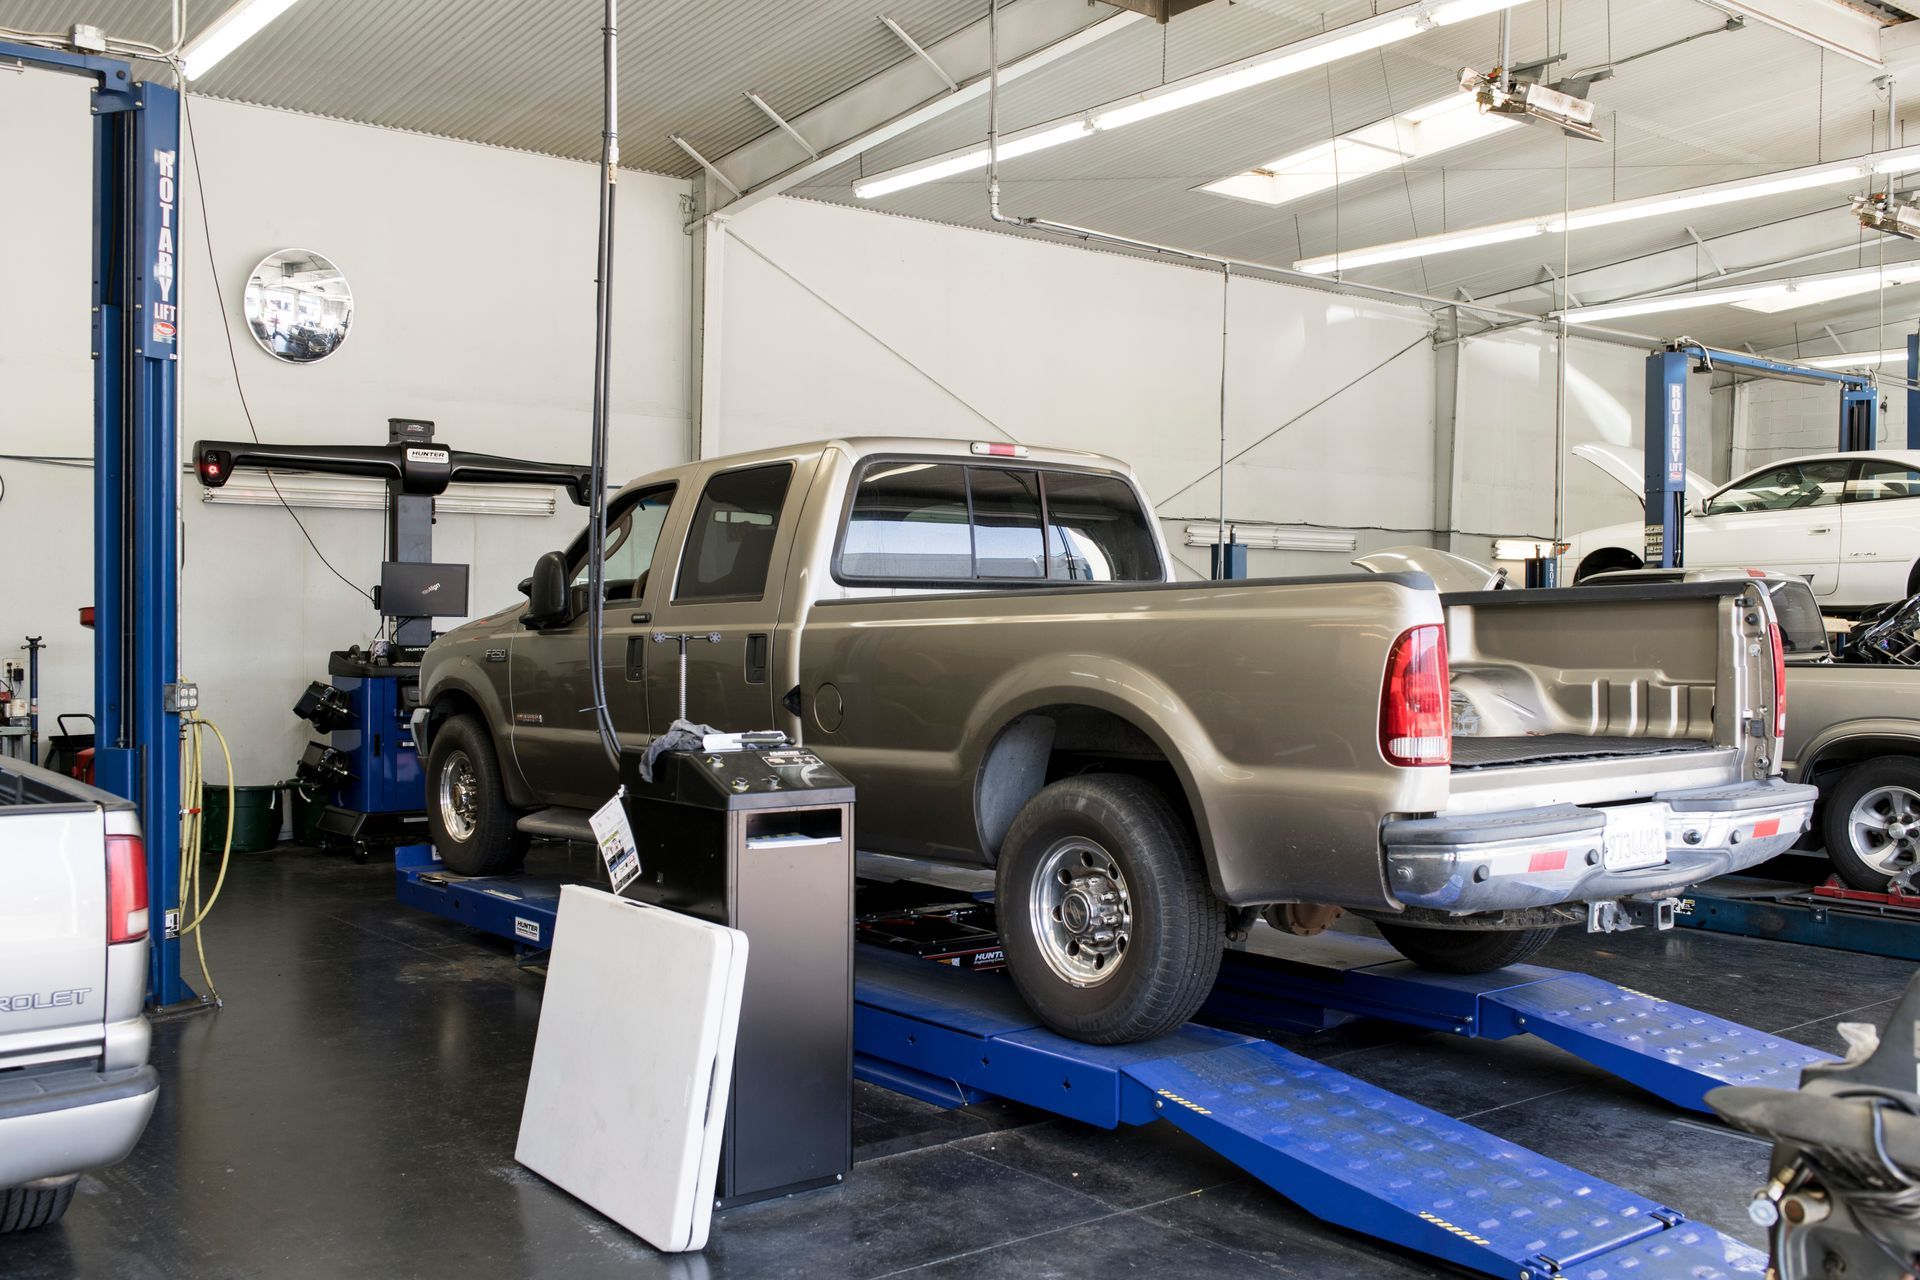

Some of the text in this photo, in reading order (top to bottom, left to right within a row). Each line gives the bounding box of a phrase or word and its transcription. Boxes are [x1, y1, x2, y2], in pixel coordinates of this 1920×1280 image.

[157, 150, 174, 302] ROTARY
[154, 302, 176, 322] LIFT
[1670, 384, 1682, 462] ROTARY
[411, 450, 445, 458] HUNTER
[1668, 462, 1683, 473] LIFT
[517, 920, 539, 933] HUNTER
[0, 988, 92, 1012] ROLET
